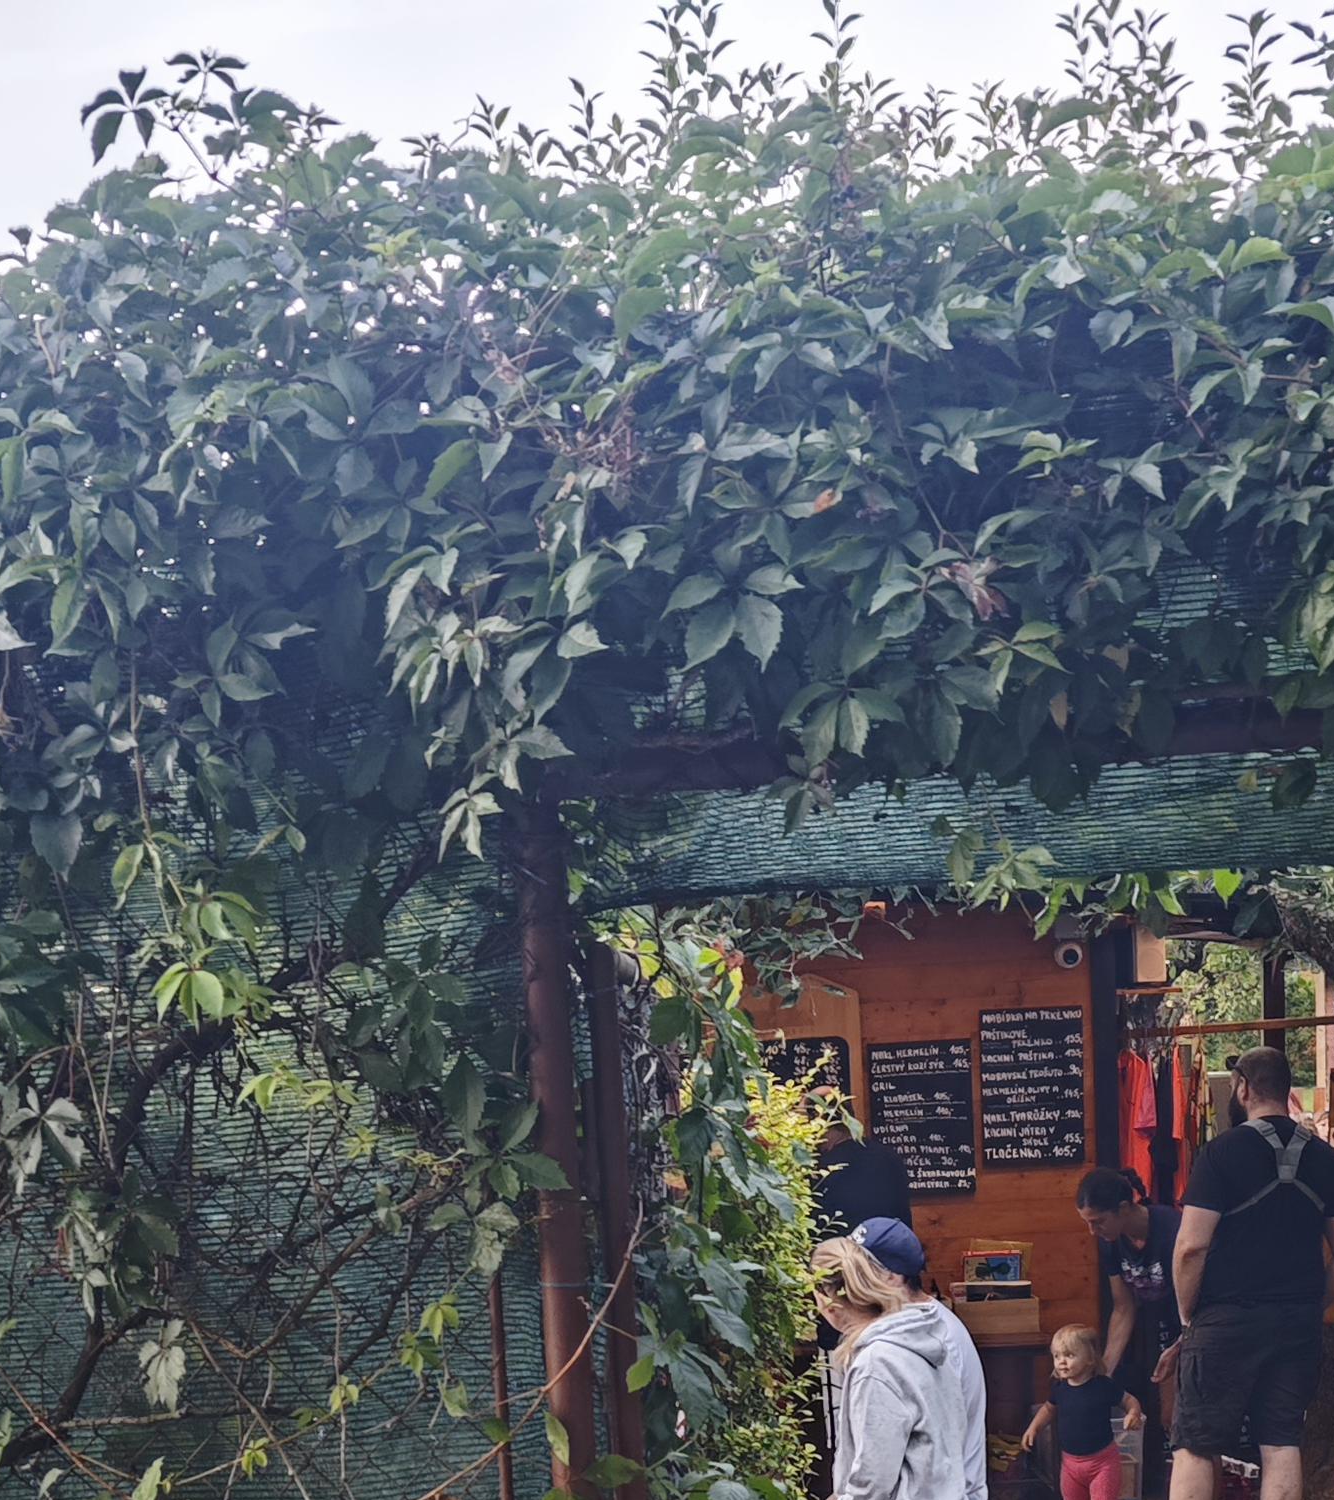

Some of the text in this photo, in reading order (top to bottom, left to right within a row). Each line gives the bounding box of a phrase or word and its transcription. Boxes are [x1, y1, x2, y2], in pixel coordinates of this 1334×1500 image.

[982, 1011, 1023, 1023] NABÍDKA
[1025, 1012, 1037, 1021] NA
[929, 1058, 945, 1069] SÝR
[871, 1082, 896, 1092] GRIL
[985, 1144, 1041, 1160] TLOČENKA
